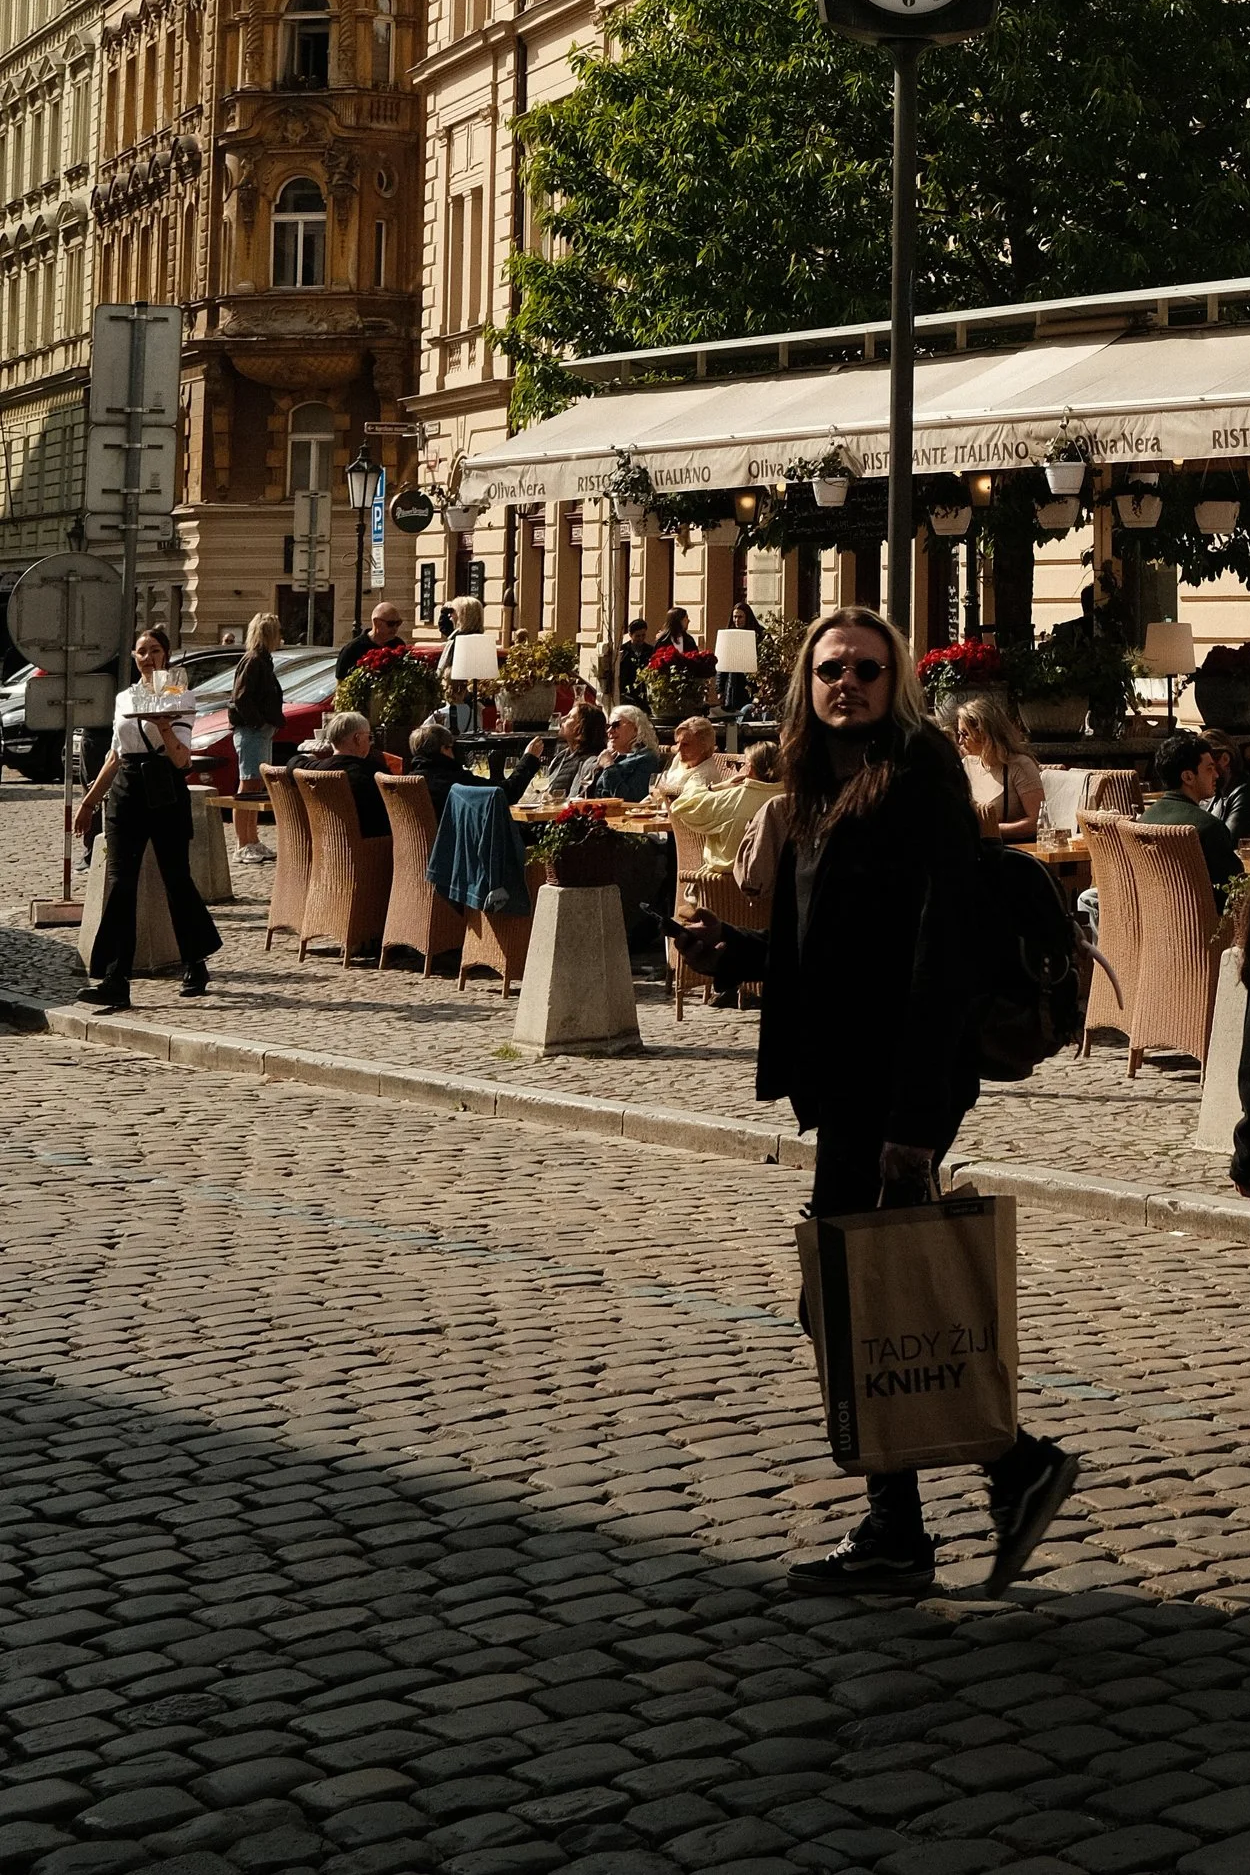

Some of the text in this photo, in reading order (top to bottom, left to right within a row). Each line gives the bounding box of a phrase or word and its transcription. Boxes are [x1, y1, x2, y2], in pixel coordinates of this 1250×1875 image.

[1121, 431, 1162, 454] Nera
[488, 481, 517, 499] Oliva
[519, 479, 546, 497] Nera
[654, 465, 711, 486] ITALIANO
[748, 459, 784, 479] Oliva
[863, 446, 947, 470] RISTANTE
[953, 441, 1029, 464] ITALIANO
[861, 1331, 941, 1364] TADY
[865, 1362, 966, 1398] KNIHY
[838, 1399, 851, 1452] LUXOR
